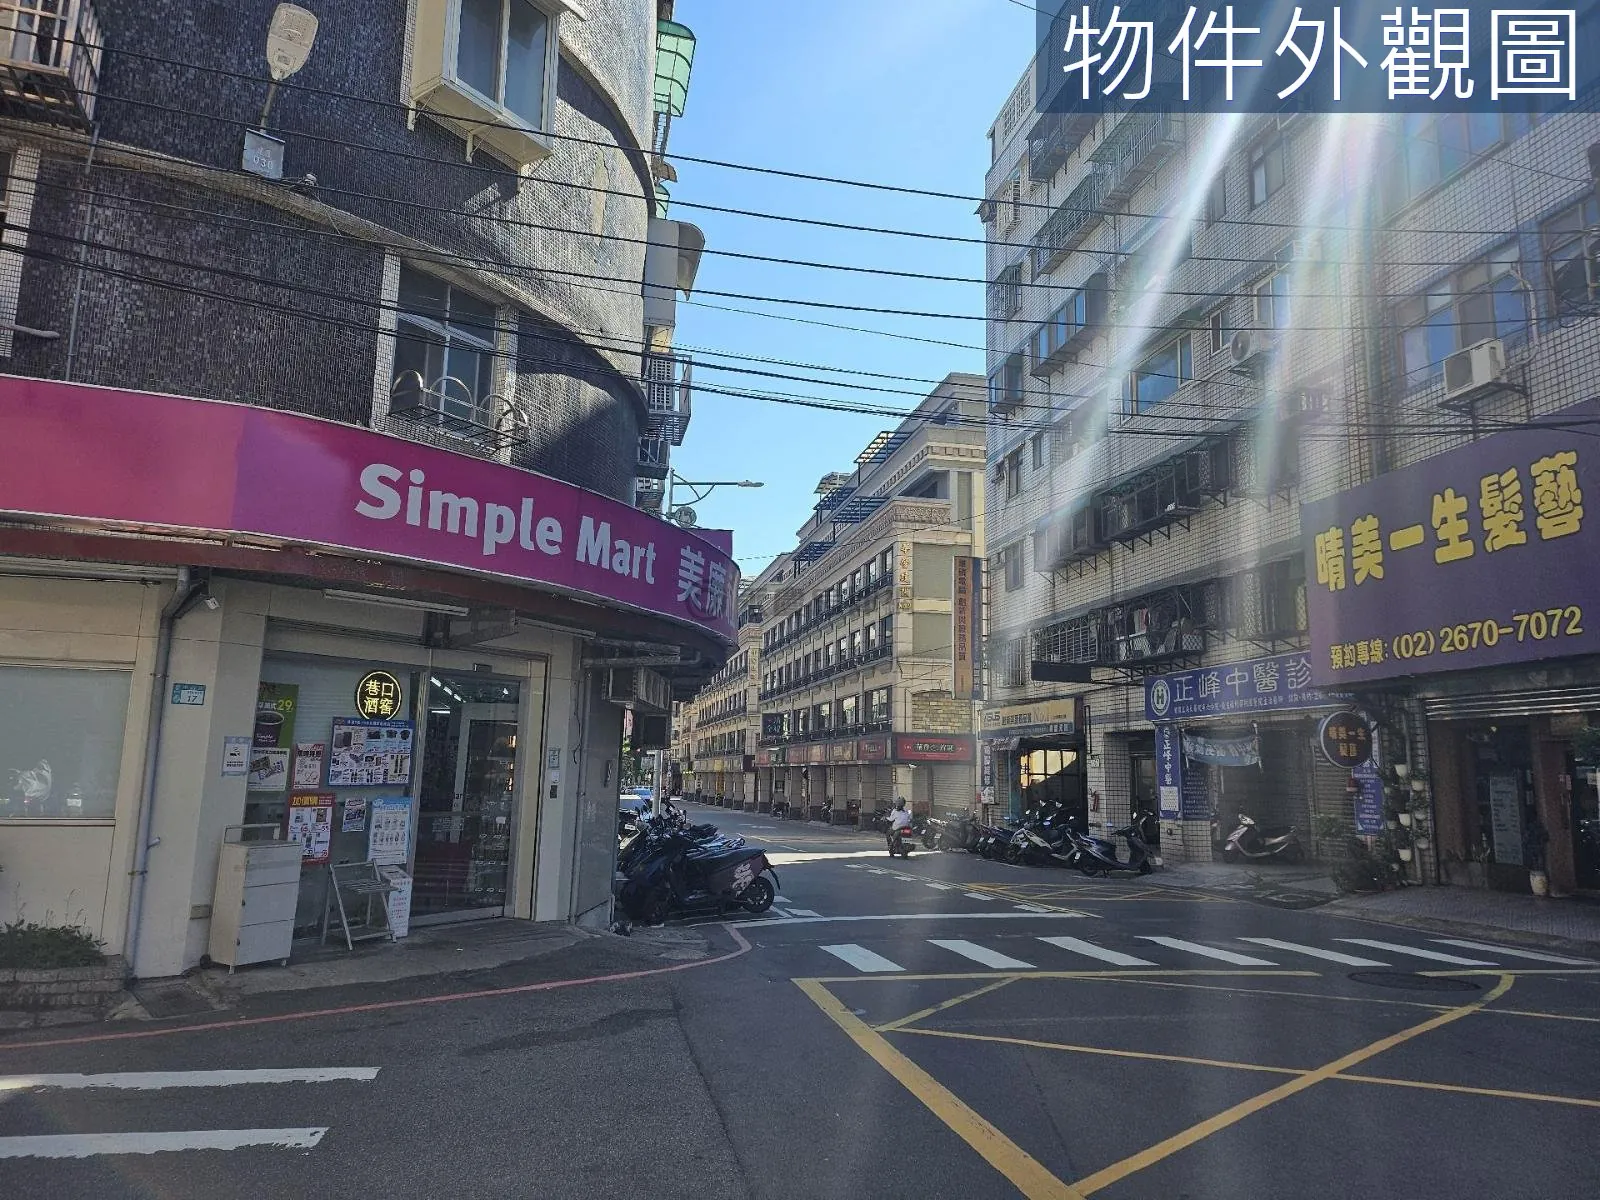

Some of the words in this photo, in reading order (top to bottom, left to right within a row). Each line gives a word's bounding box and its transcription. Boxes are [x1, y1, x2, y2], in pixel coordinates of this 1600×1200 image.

[354, 463, 563, 555] Simple
[576, 515, 656, 585] Mart
[1314, 450, 1584, 593] 晴美一生髮藝
[1439, 606, 1583, 653] 2670-7072
[365, 680, 394, 697] 巷口
[278, 700, 293, 712] 29
[364, 696, 394, 715] 酒窖
